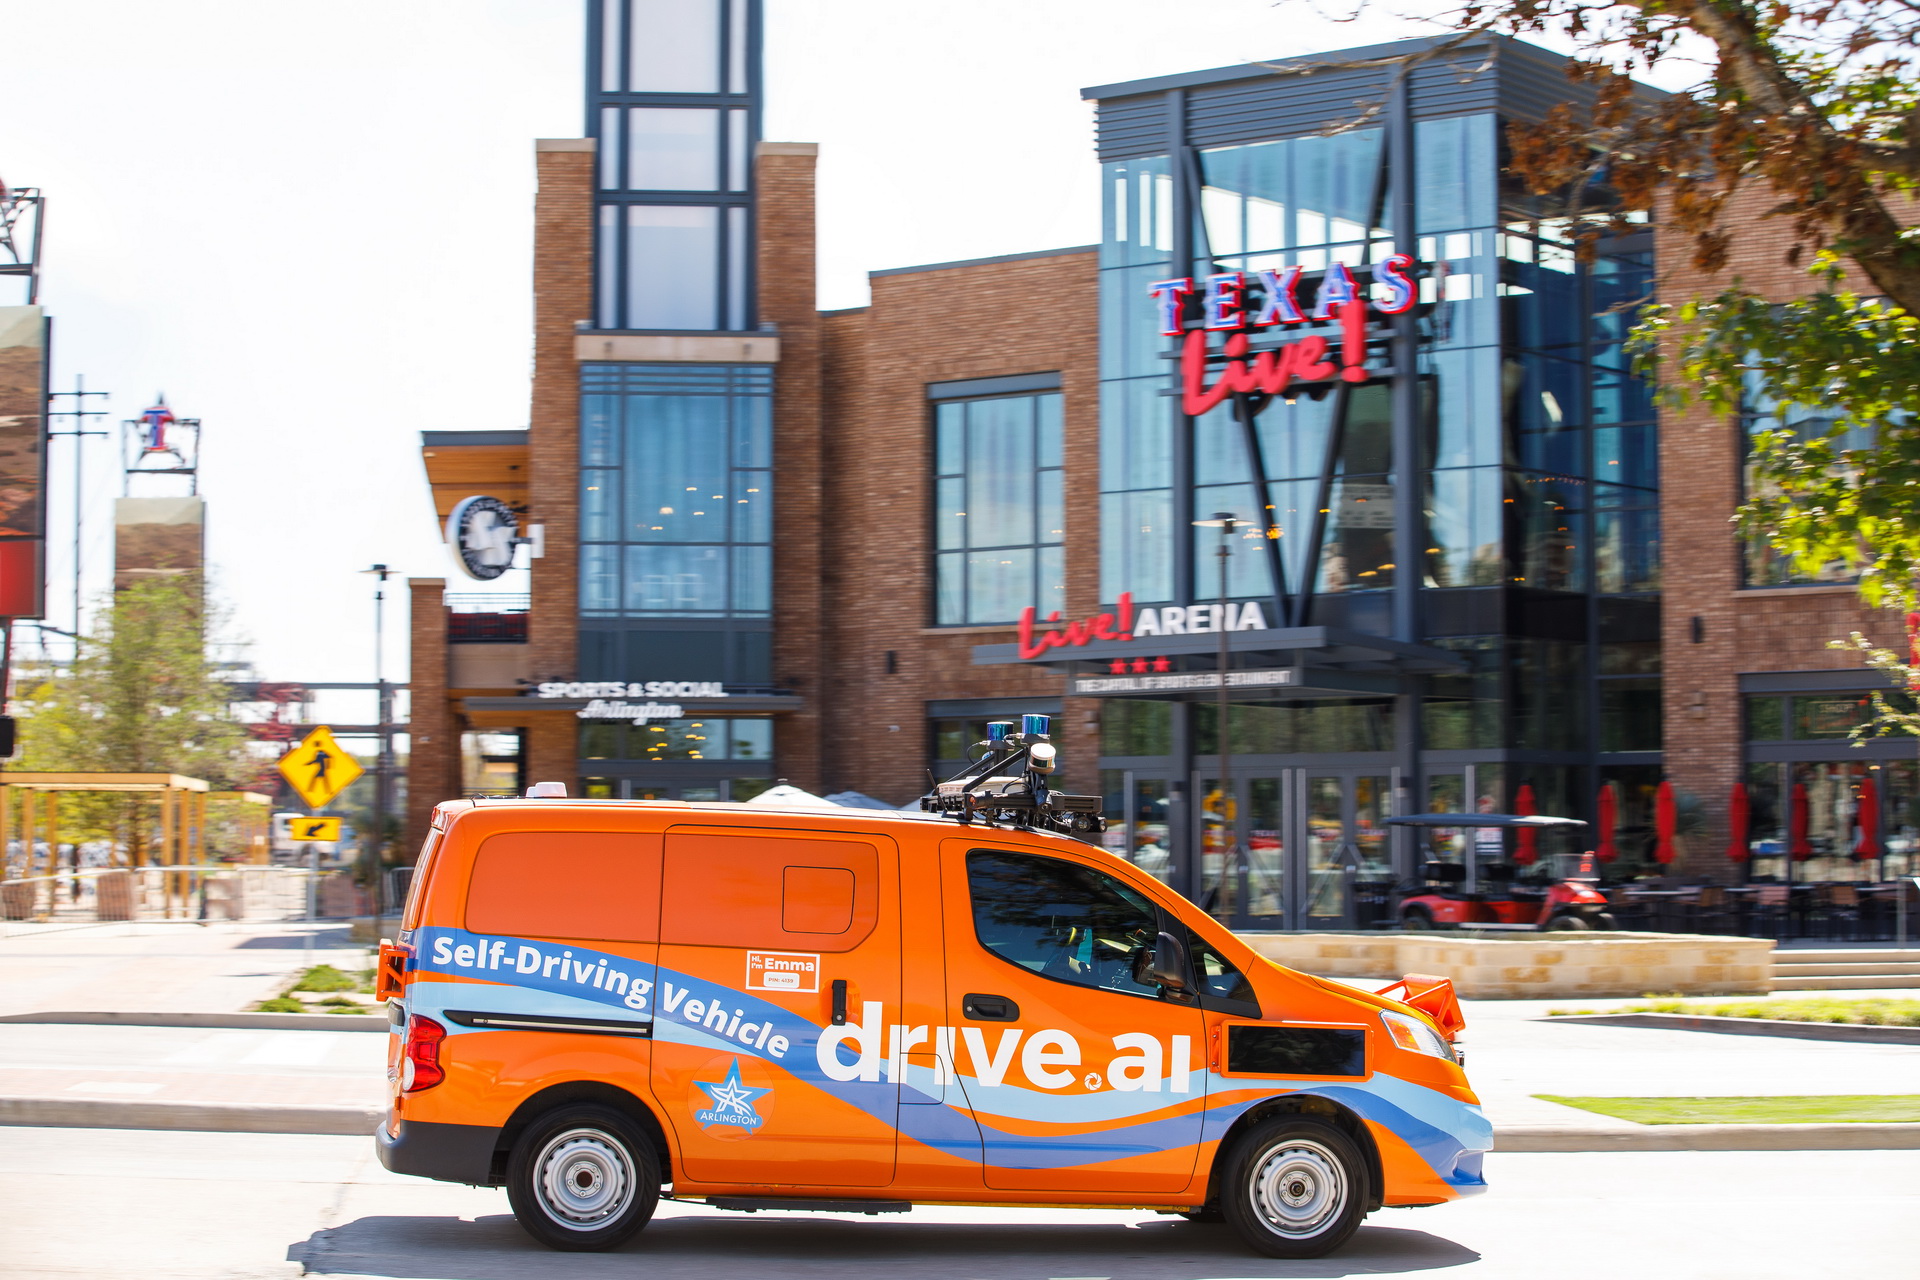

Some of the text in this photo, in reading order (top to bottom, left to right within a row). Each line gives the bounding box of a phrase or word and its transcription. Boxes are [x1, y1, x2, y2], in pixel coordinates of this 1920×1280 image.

[1147, 253, 1418, 336] TEXAS
[1180, 298, 1368, 416] Live!
[1017, 591, 1268, 660] Live! ARENA
[538, 681, 627, 698] SPORTS
[644, 681, 730, 698] SOCIAL
[751, 955, 762, 963] Hi,
[764, 957, 815, 972] Emma
[432, 936, 790, 1059] Self-Driving Vehicle
[816, 1001, 1191, 1093] drive.ai
[700, 1111, 757, 1125] ARLINGTON
